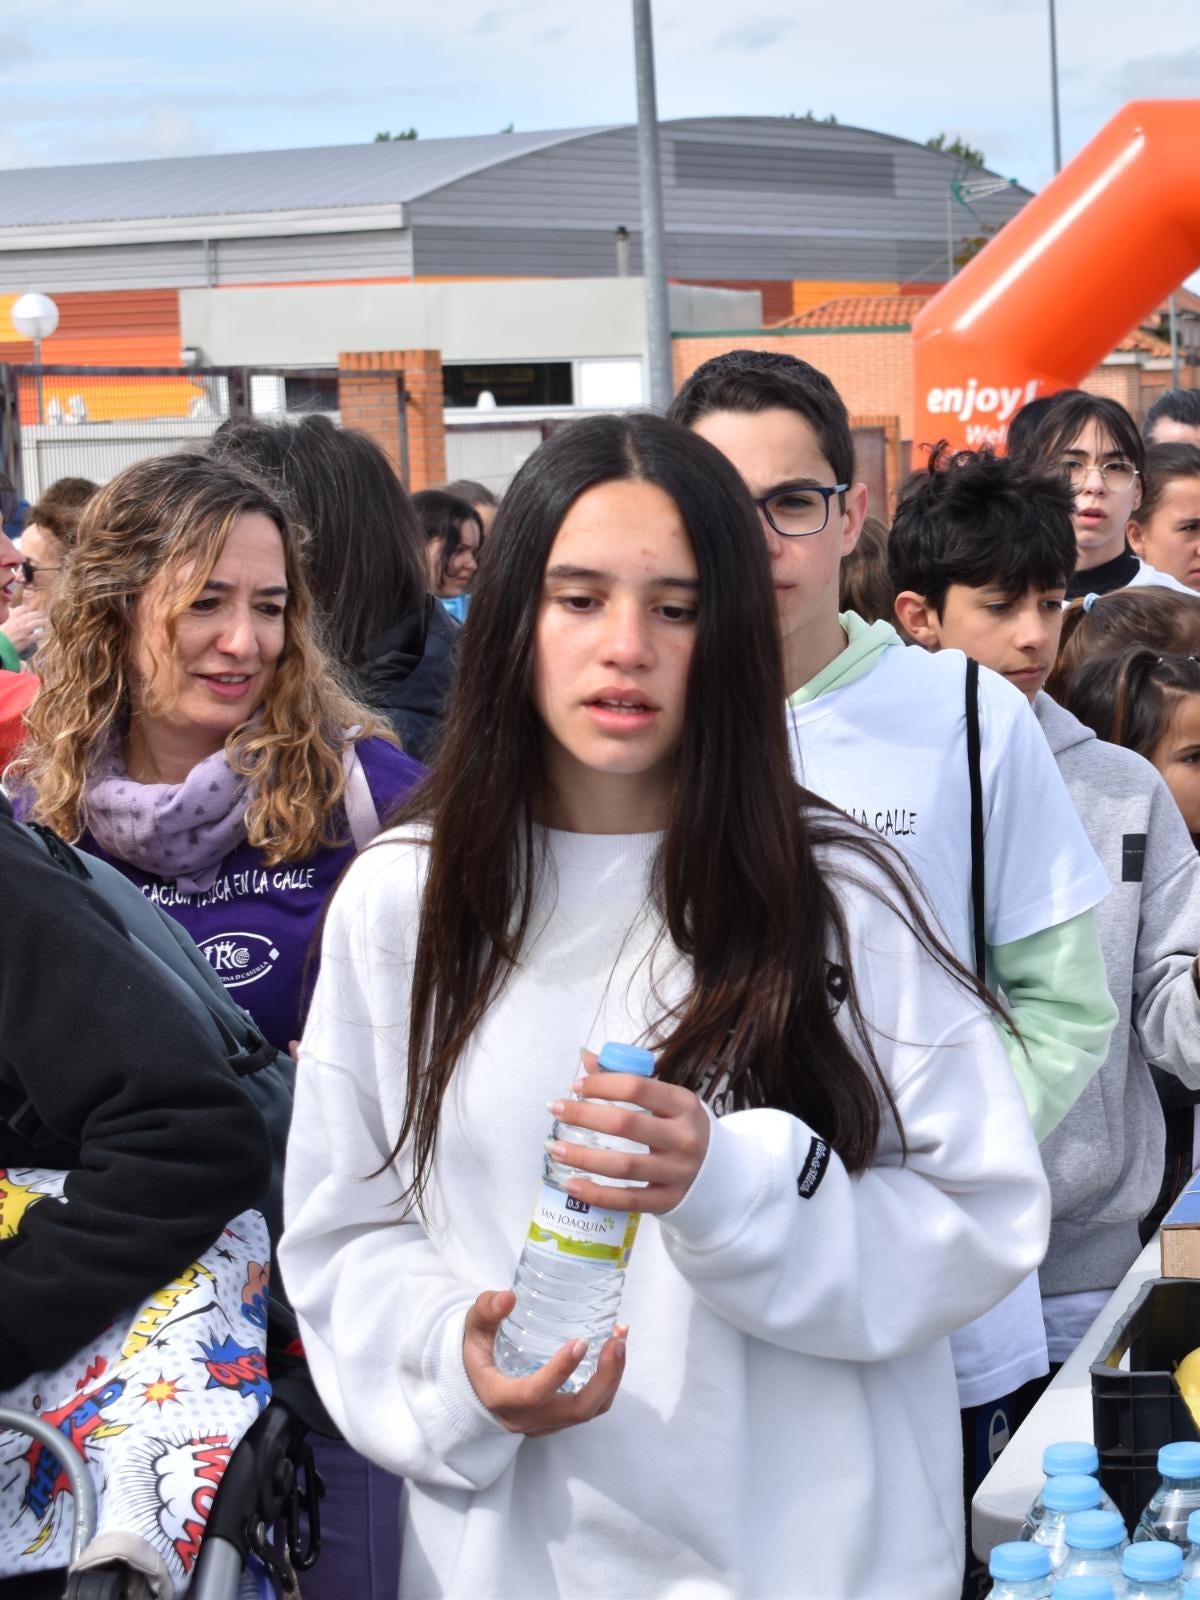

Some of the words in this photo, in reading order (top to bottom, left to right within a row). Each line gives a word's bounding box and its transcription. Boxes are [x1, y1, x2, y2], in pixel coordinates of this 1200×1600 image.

[875, 808, 919, 837] CALLE
[233, 869, 250, 896] EN
[252, 869, 269, 894] LA
[272, 867, 316, 891] CALLE
[541, 1207, 556, 1221] SAN
